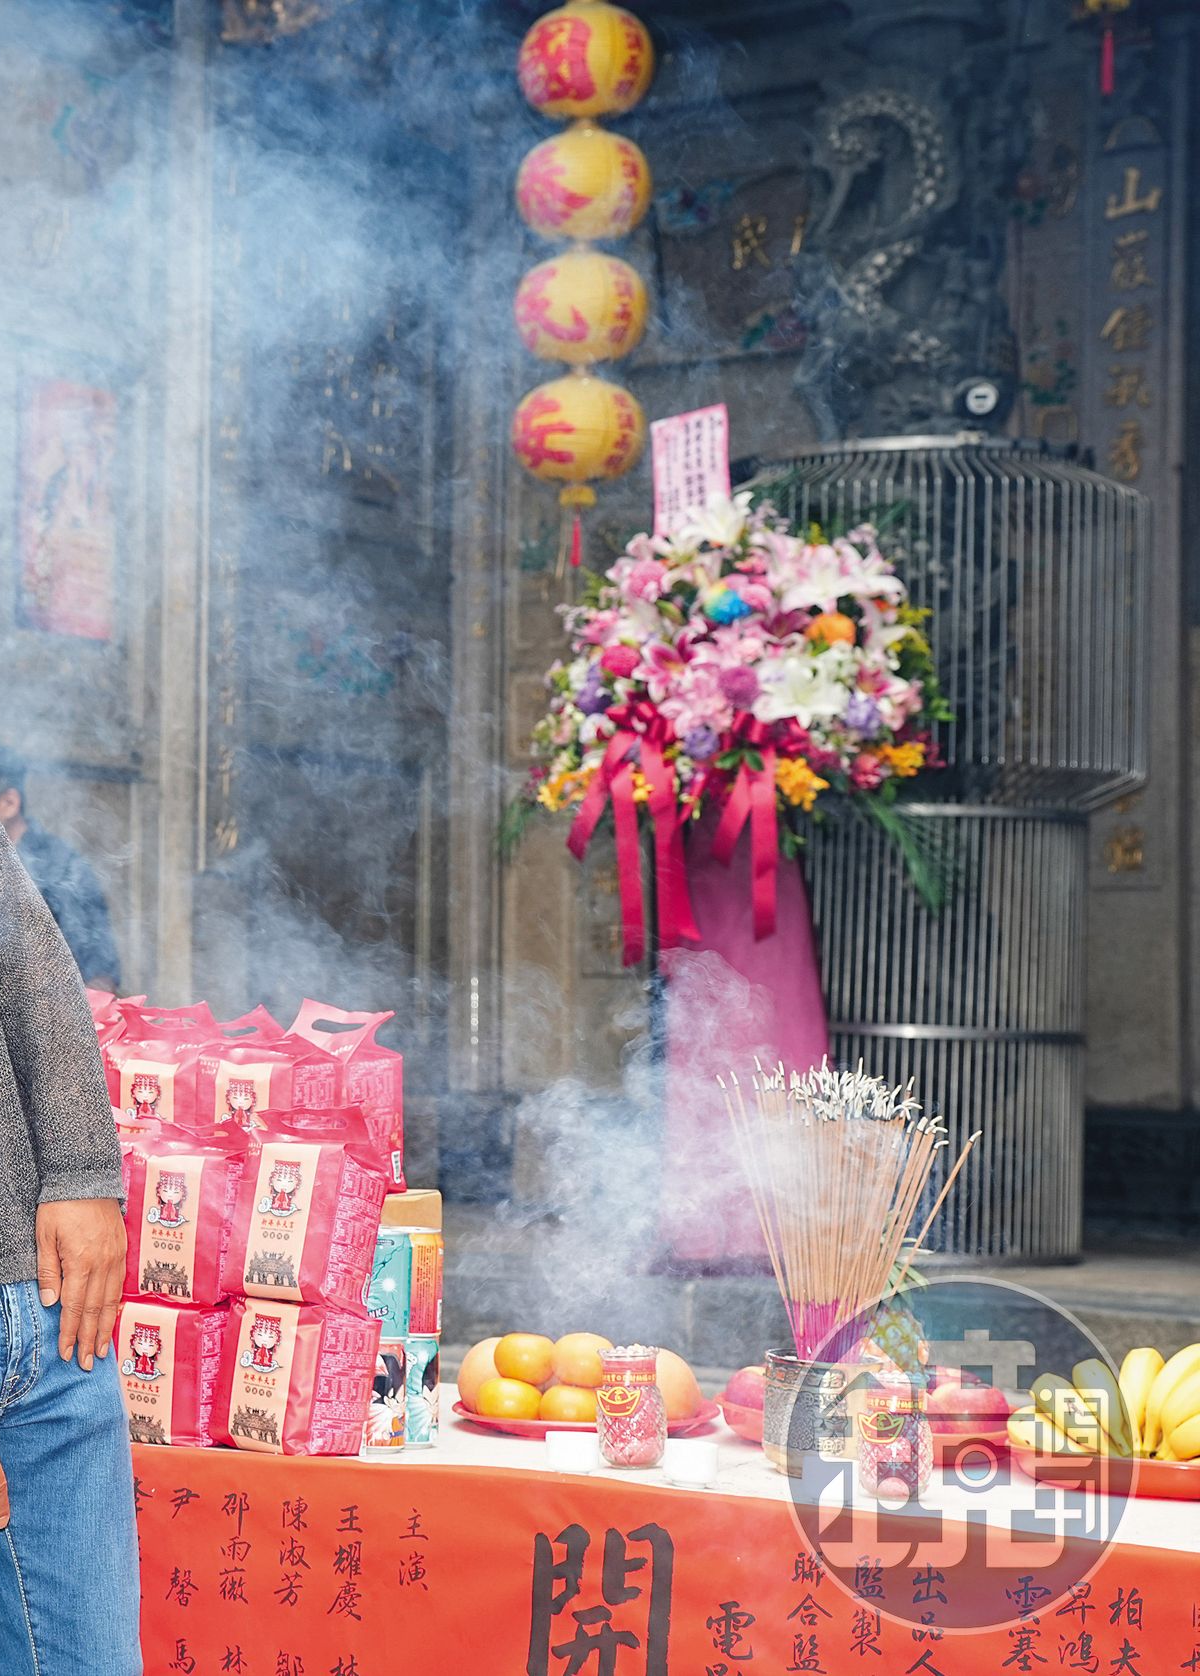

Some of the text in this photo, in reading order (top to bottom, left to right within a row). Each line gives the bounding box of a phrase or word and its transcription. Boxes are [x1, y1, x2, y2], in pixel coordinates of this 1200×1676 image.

[219, 1492, 251, 1674] 邵雨薇 林
[274, 1496, 311, 1607] 陳淑芳
[327, 1505, 363, 1621] 王耀慶
[399, 1508, 428, 1591] 主演
[526, 1522, 675, 1676] 開
[706, 1600, 756, 1676] 電
[905, 1562, 949, 1676] 出品人
